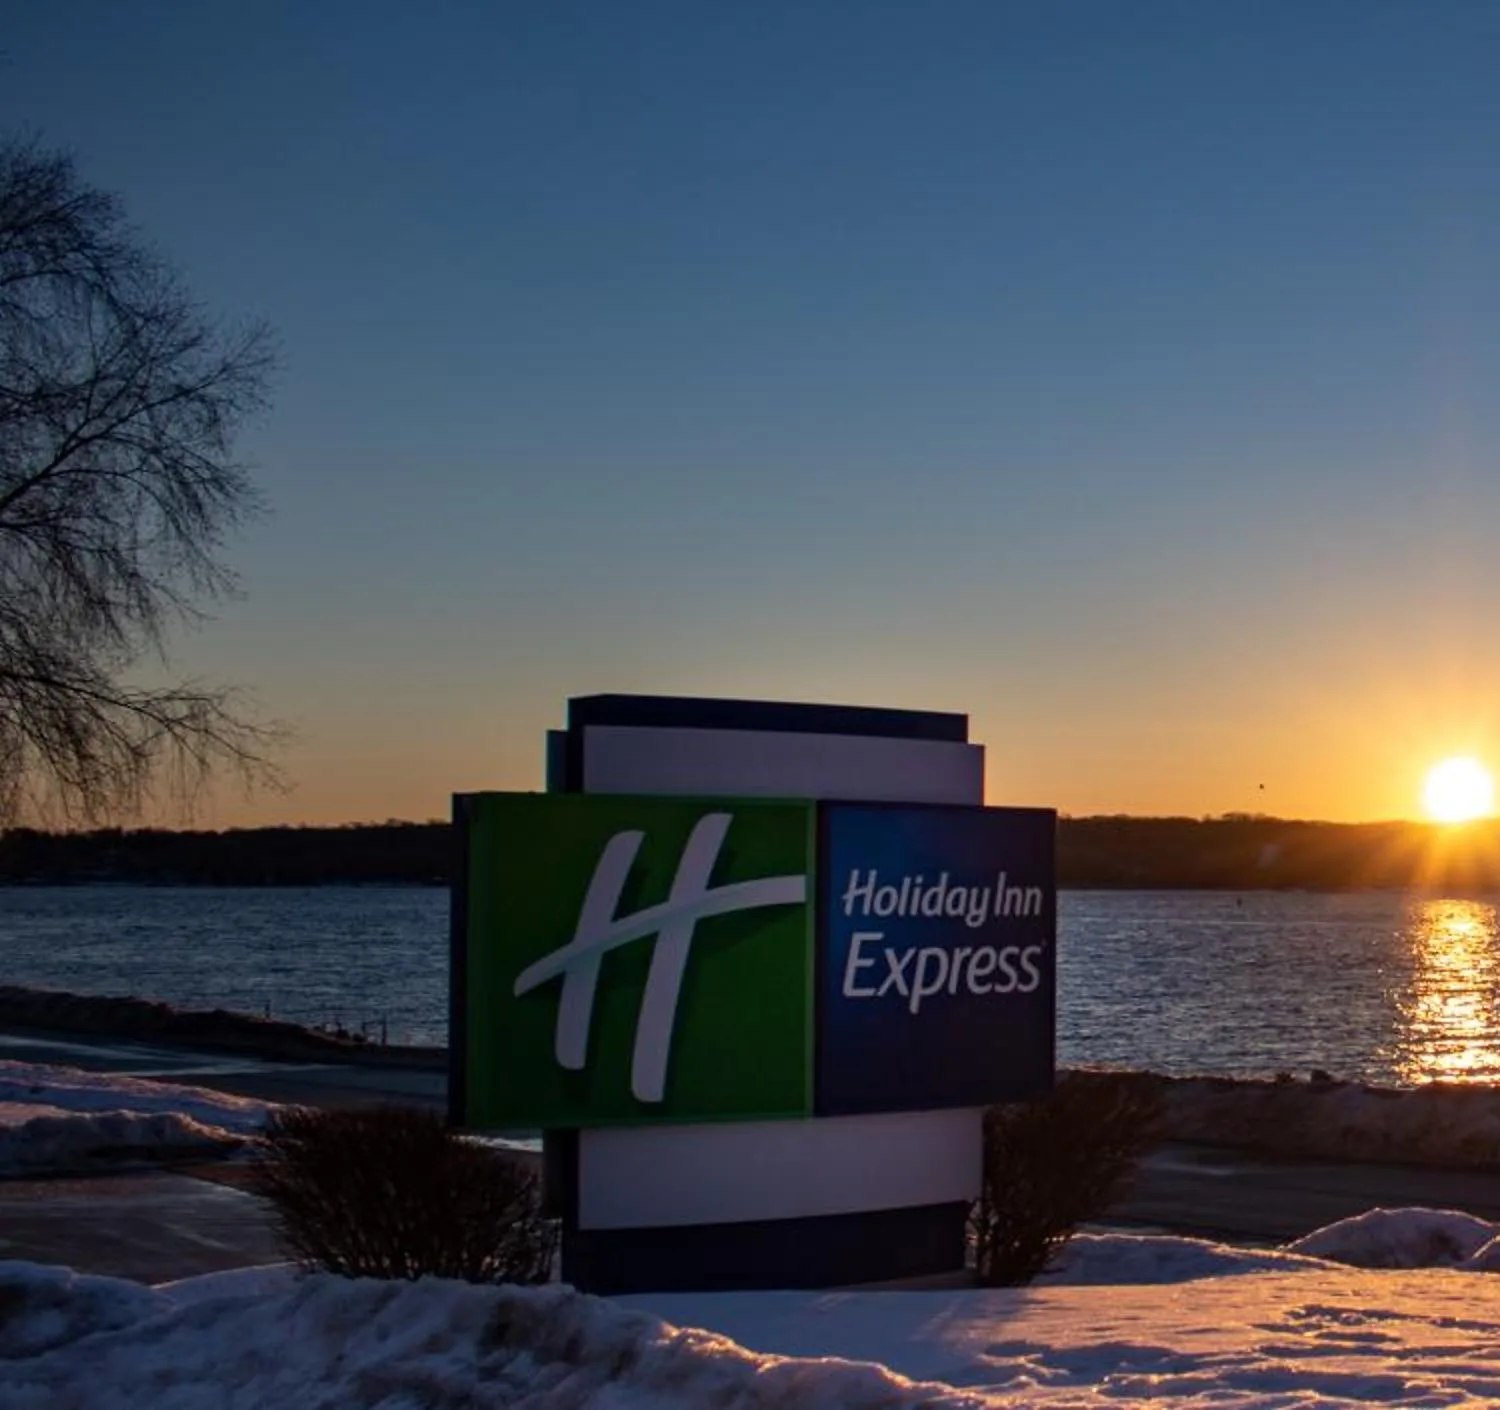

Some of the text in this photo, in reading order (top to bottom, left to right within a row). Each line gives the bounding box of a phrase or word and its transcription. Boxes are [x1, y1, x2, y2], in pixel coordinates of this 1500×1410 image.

[842, 868, 1043, 928] Holiday Inn
[512, 812, 807, 1102] H
[842, 931, 1043, 1015] Express
